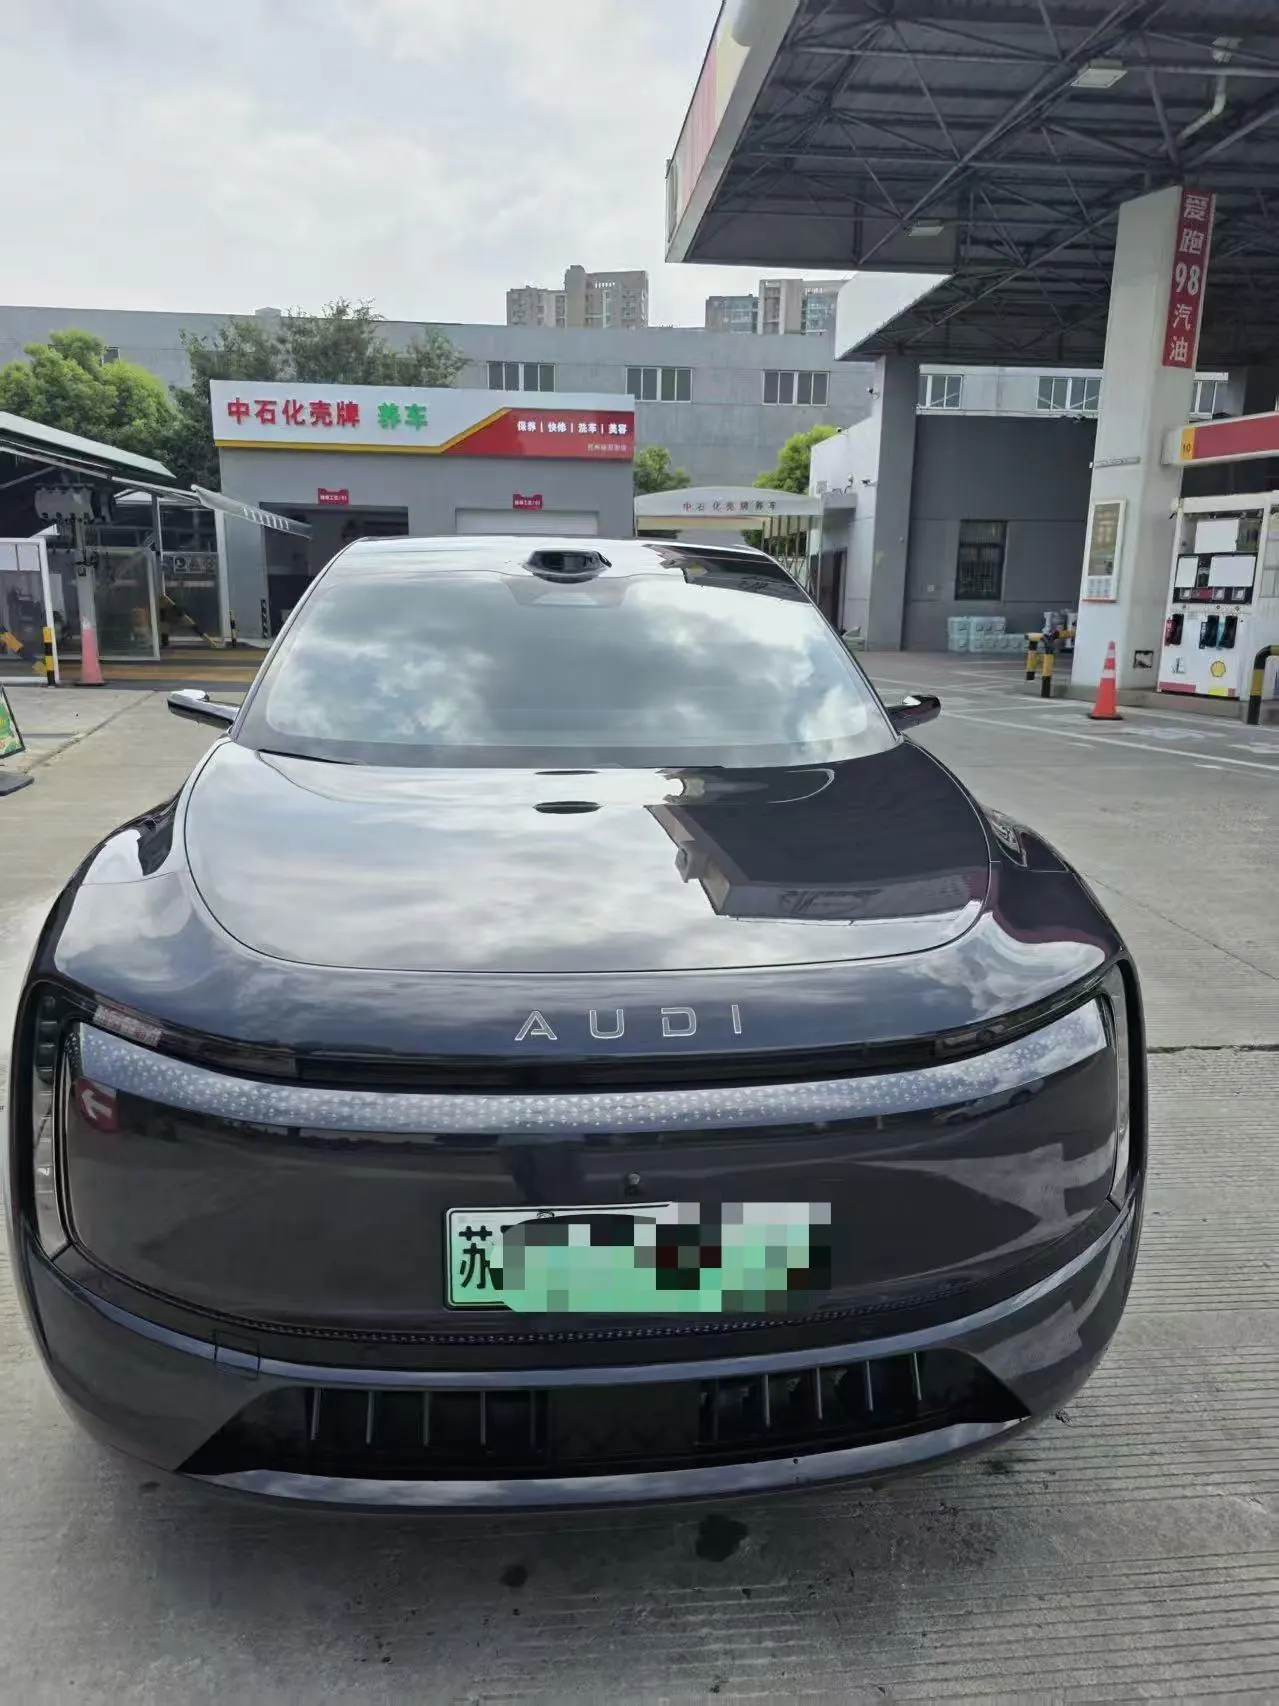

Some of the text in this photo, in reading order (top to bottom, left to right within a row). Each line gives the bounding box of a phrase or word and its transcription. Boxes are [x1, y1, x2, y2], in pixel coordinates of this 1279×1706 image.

[1169, 194, 1209, 363] 爱跑98汽油
[227, 397, 428, 431] 中石化壳牌 养车
[683, 501, 777, 511] 中石化壳牌养车
[513, 1004, 742, 1042] AUDI
